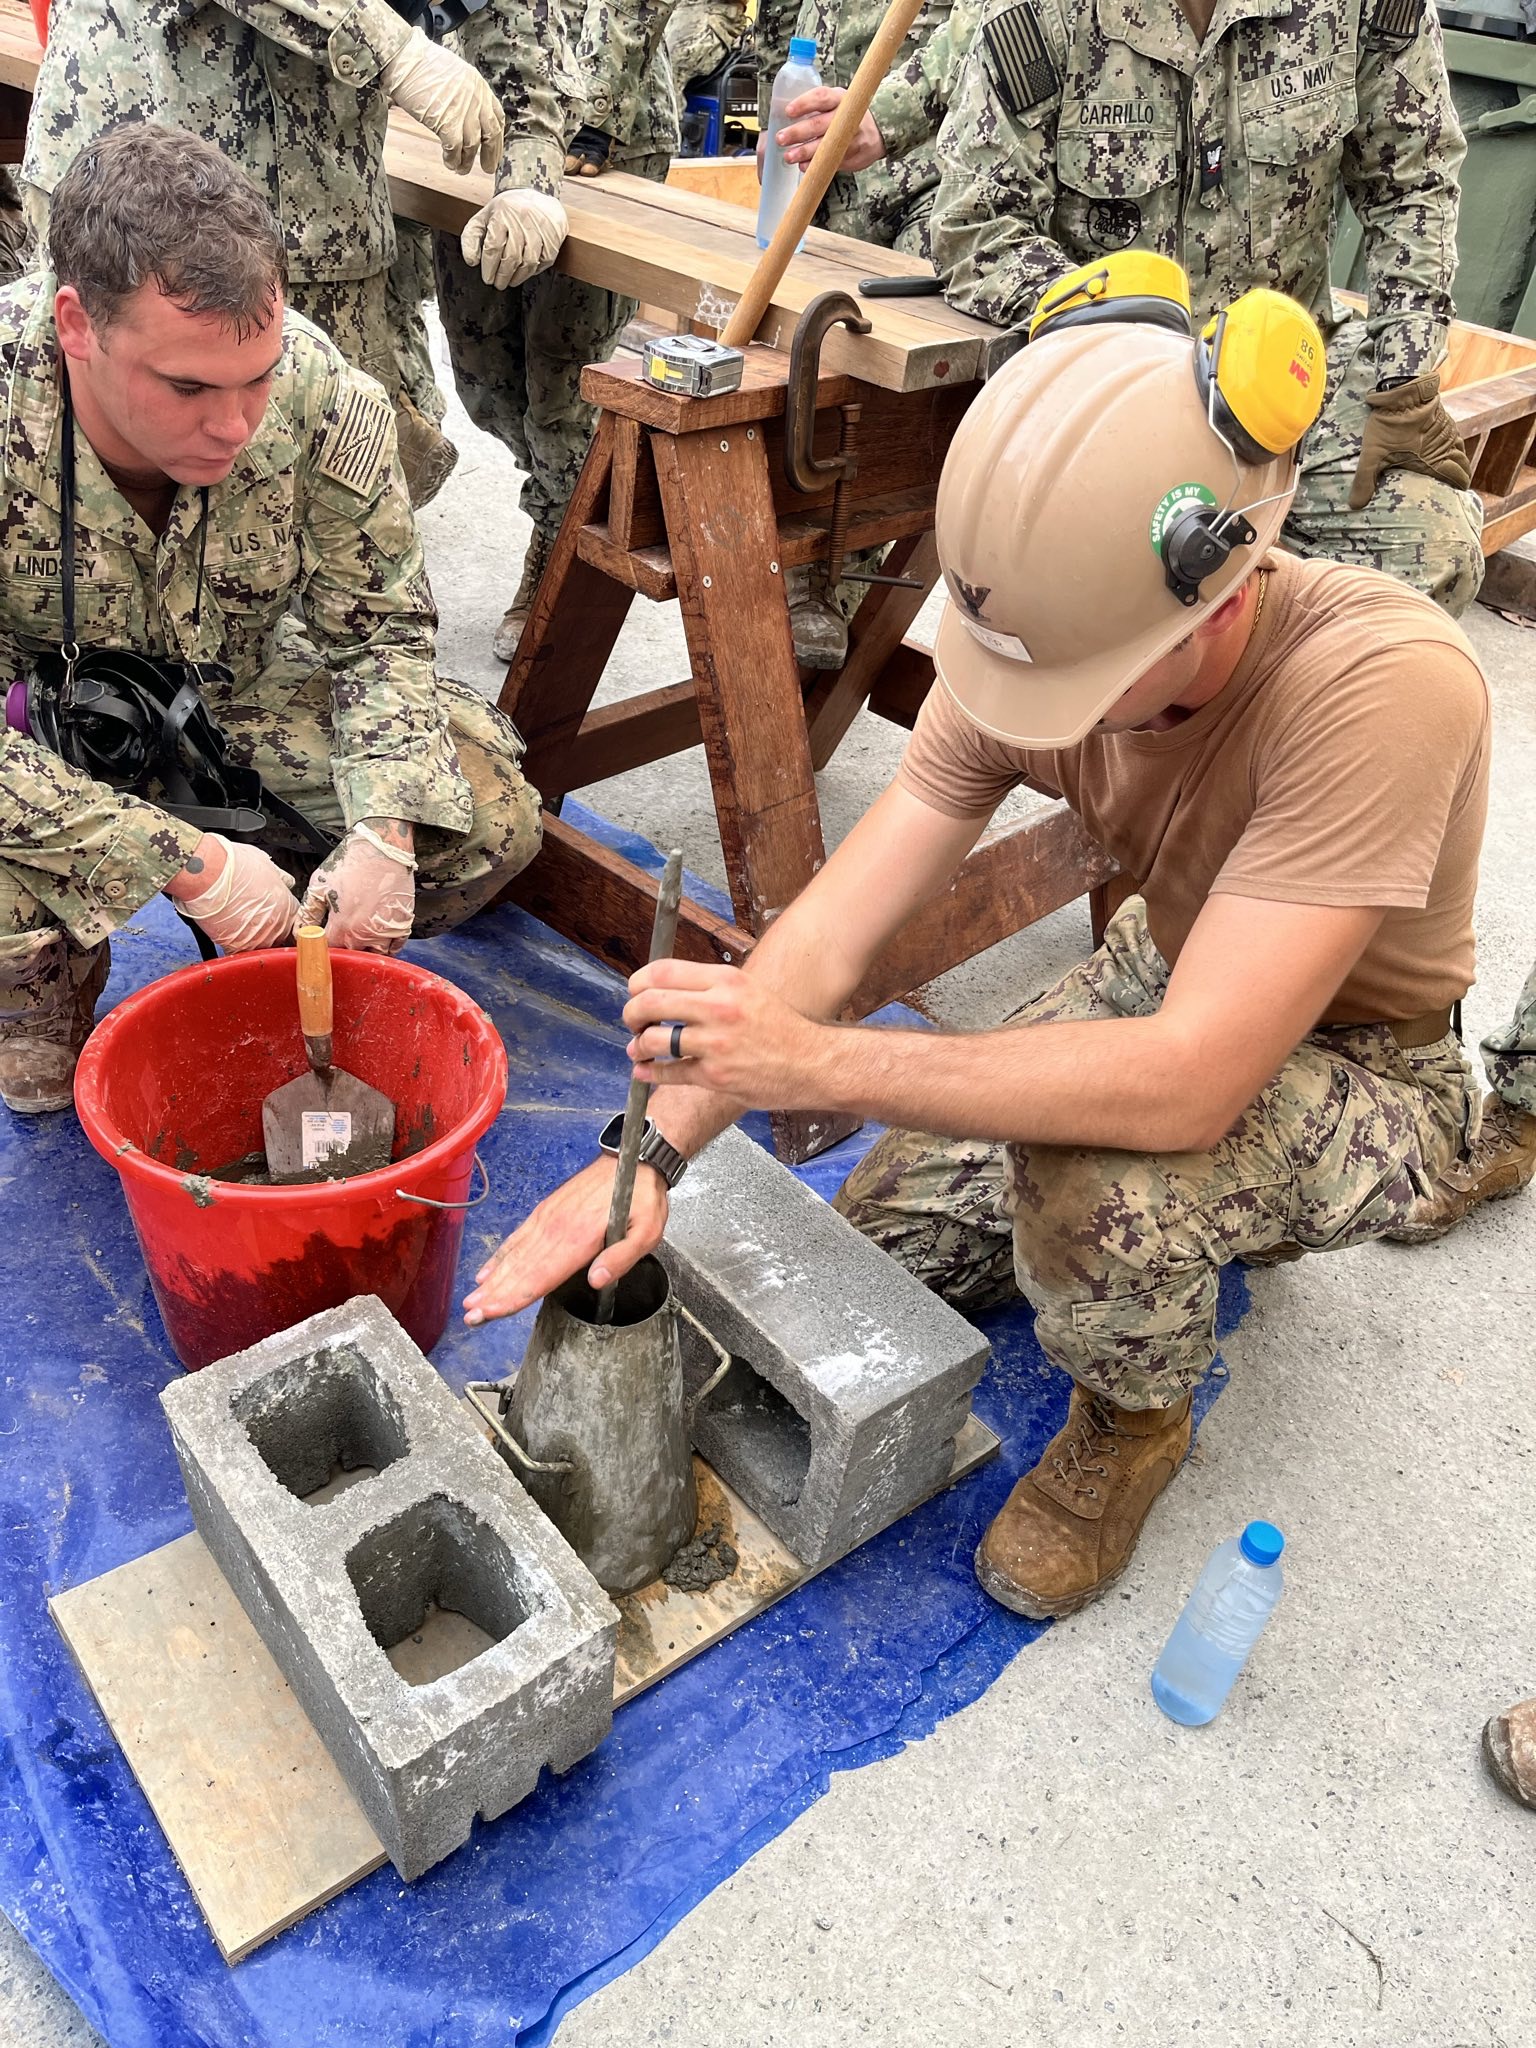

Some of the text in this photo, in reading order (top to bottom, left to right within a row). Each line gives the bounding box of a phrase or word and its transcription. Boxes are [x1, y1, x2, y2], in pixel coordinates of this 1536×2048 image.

[1271, 61, 1333, 98] U.S. NAVY
[1080, 103, 1154, 125] CARRILLO
[1288, 359, 1310, 388] 3M
[1152, 487, 1201, 542] SAFETY IS MY
[229, 532, 267, 554] U.S.
[15, 555, 96, 577] LINDEY
